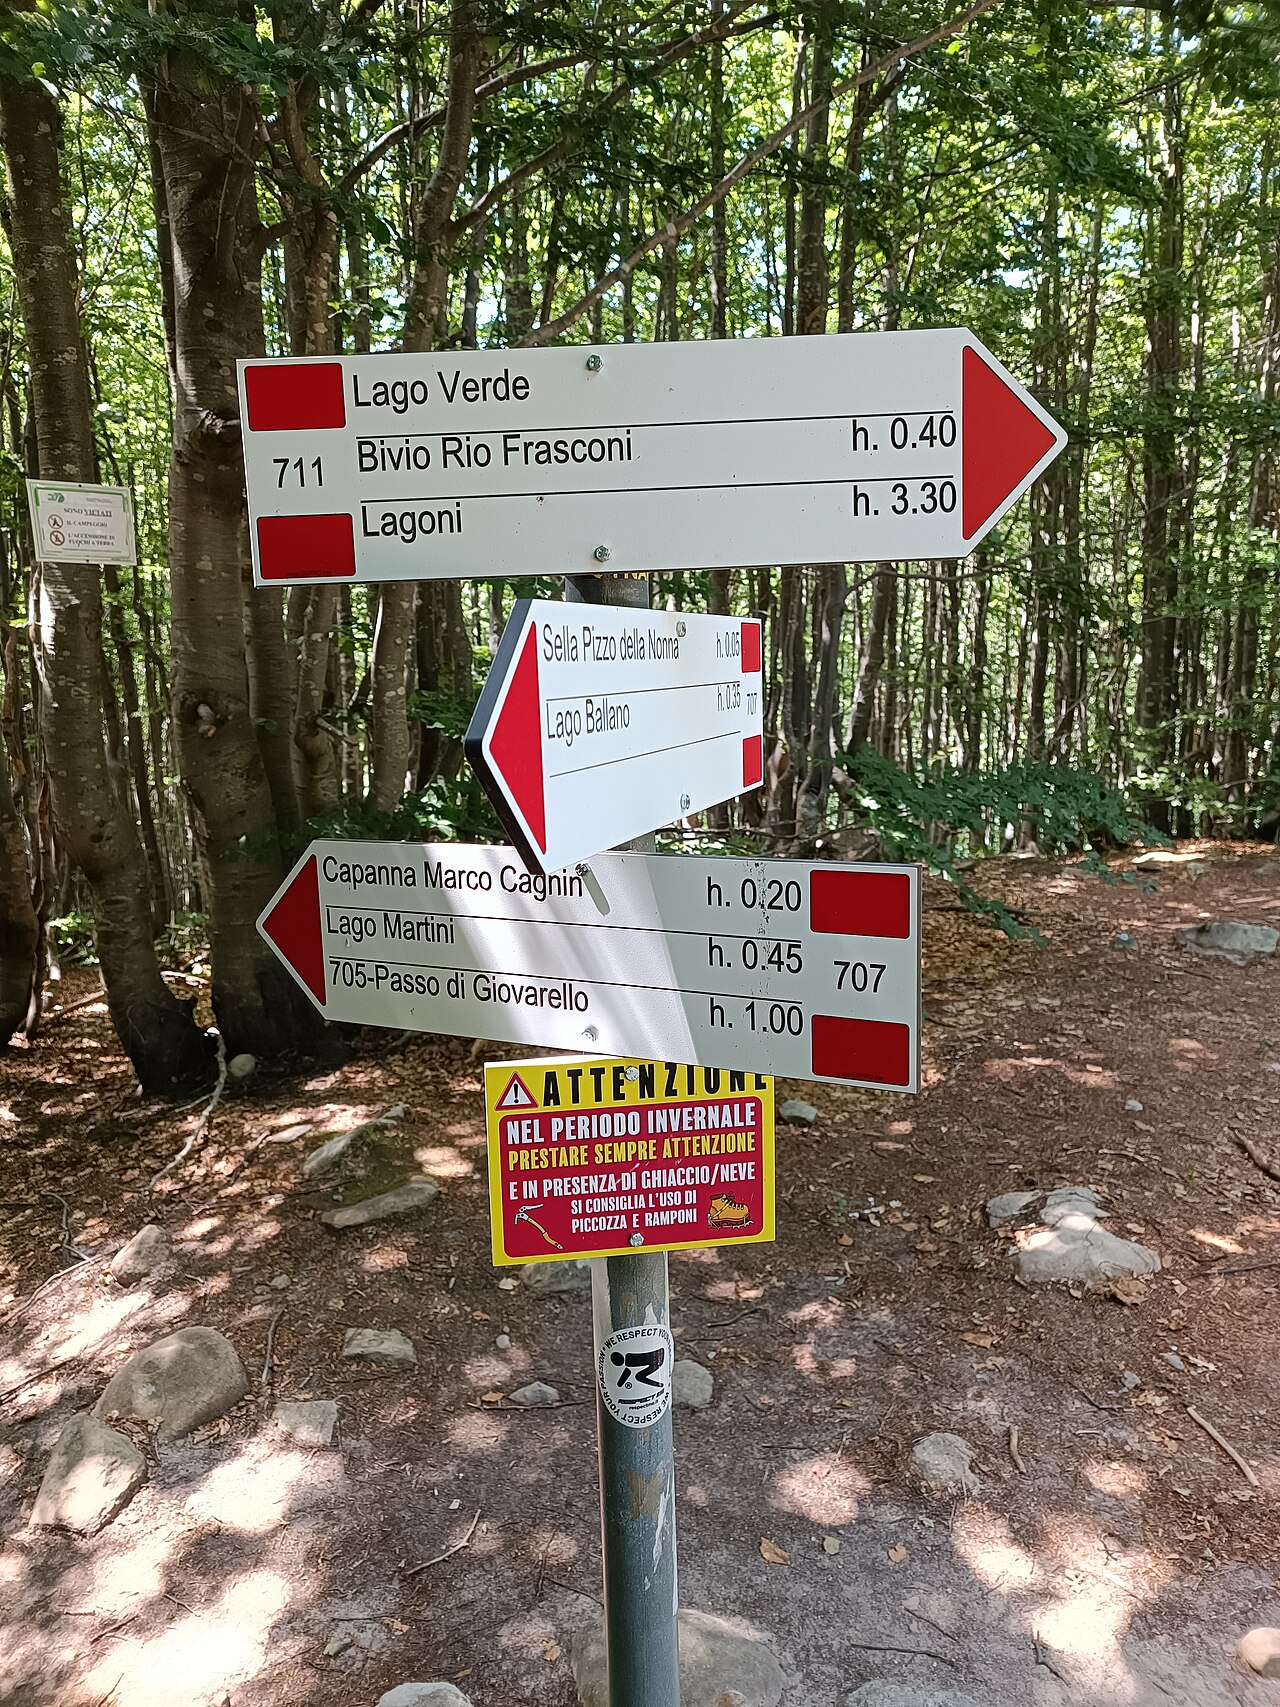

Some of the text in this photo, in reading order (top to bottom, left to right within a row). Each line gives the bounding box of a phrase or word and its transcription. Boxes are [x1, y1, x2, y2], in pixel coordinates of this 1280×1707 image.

[352, 368, 530, 414] Lago Verde
[357, 428, 633, 473] Bivio Rio Frasconi
[851, 414, 957, 451] h. 0.40
[272, 456, 324, 489] 711
[852, 480, 957, 517] h. 3.30
[360, 501, 463, 543] Lagoni
[543, 623, 680, 662] Sella Pizzo della Nonna
[716, 631, 740, 658] h. 0.05
[717, 683, 741, 712] h. 0.35
[746, 692, 758, 716] 707
[545, 698, 630, 747] Lago Ballano
[322, 855, 417, 890] Capanna
[423, 861, 492, 891] Marco
[706, 876, 802, 912] h. 0.20
[326, 907, 455, 944] Lago Martini
[708, 936, 803, 974] h. 0.45
[329, 960, 589, 1012] 705-Passo di Giovarello
[833, 959, 887, 993] 707
[709, 997, 804, 1036] h. 1.00
[506, 1102, 757, 1145] NEL PERIODO INVERNALE
[508, 1131, 756, 1171] PRESTARE SEMPRE ATTENZIONE
[509, 1161, 756, 1200] E IN PRESENZA DI GHIACCIO/NEVE
[570, 1189, 698, 1215] SI CONSIGLIA L'USO DI
[571, 1207, 698, 1234] PICCOZZA E RAMPONI
[604, 1337, 617, 1349] WE
[617, 1328, 658, 1343] RESPECT
[598, 1350, 607, 1390] PASSION
[603, 1391, 621, 1417] YOUR
[620, 1406, 662, 1424] RESPECT
